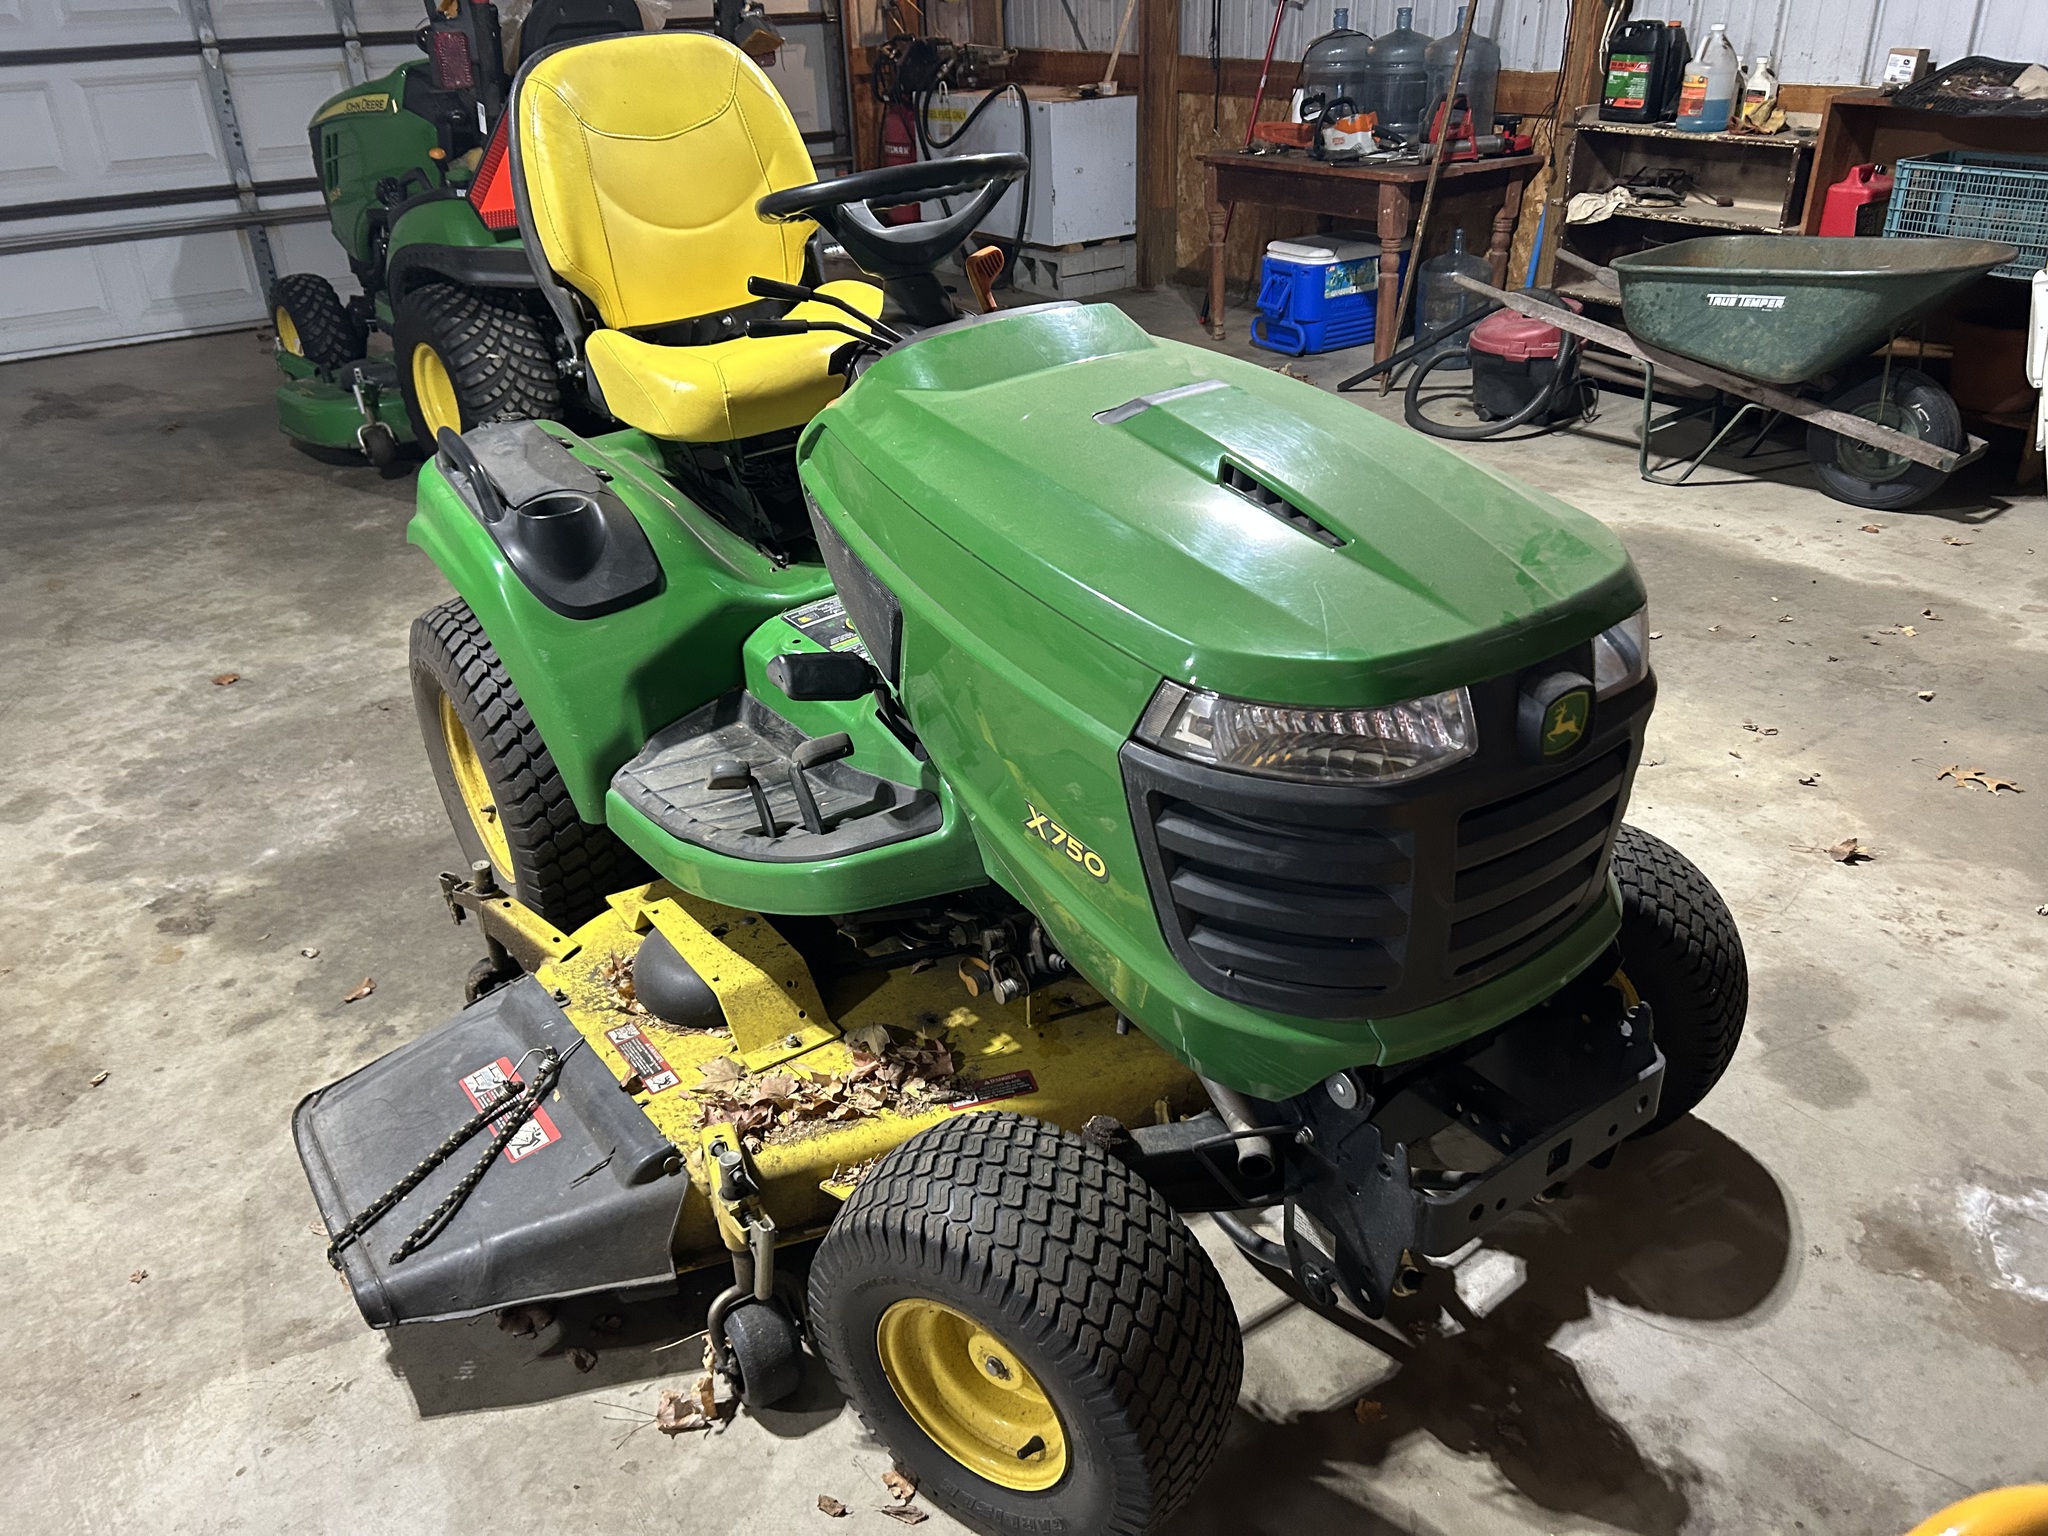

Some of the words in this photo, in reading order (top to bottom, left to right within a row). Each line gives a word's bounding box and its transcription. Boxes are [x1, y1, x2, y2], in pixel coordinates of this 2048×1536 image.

[346, 102, 361, 112] JOHN
[361, 98, 385, 111] DEERE
[1706, 293, 1739, 306] TRUE
[1738, 294, 1787, 309] TEMPER
[1024, 801, 1107, 881] X750
